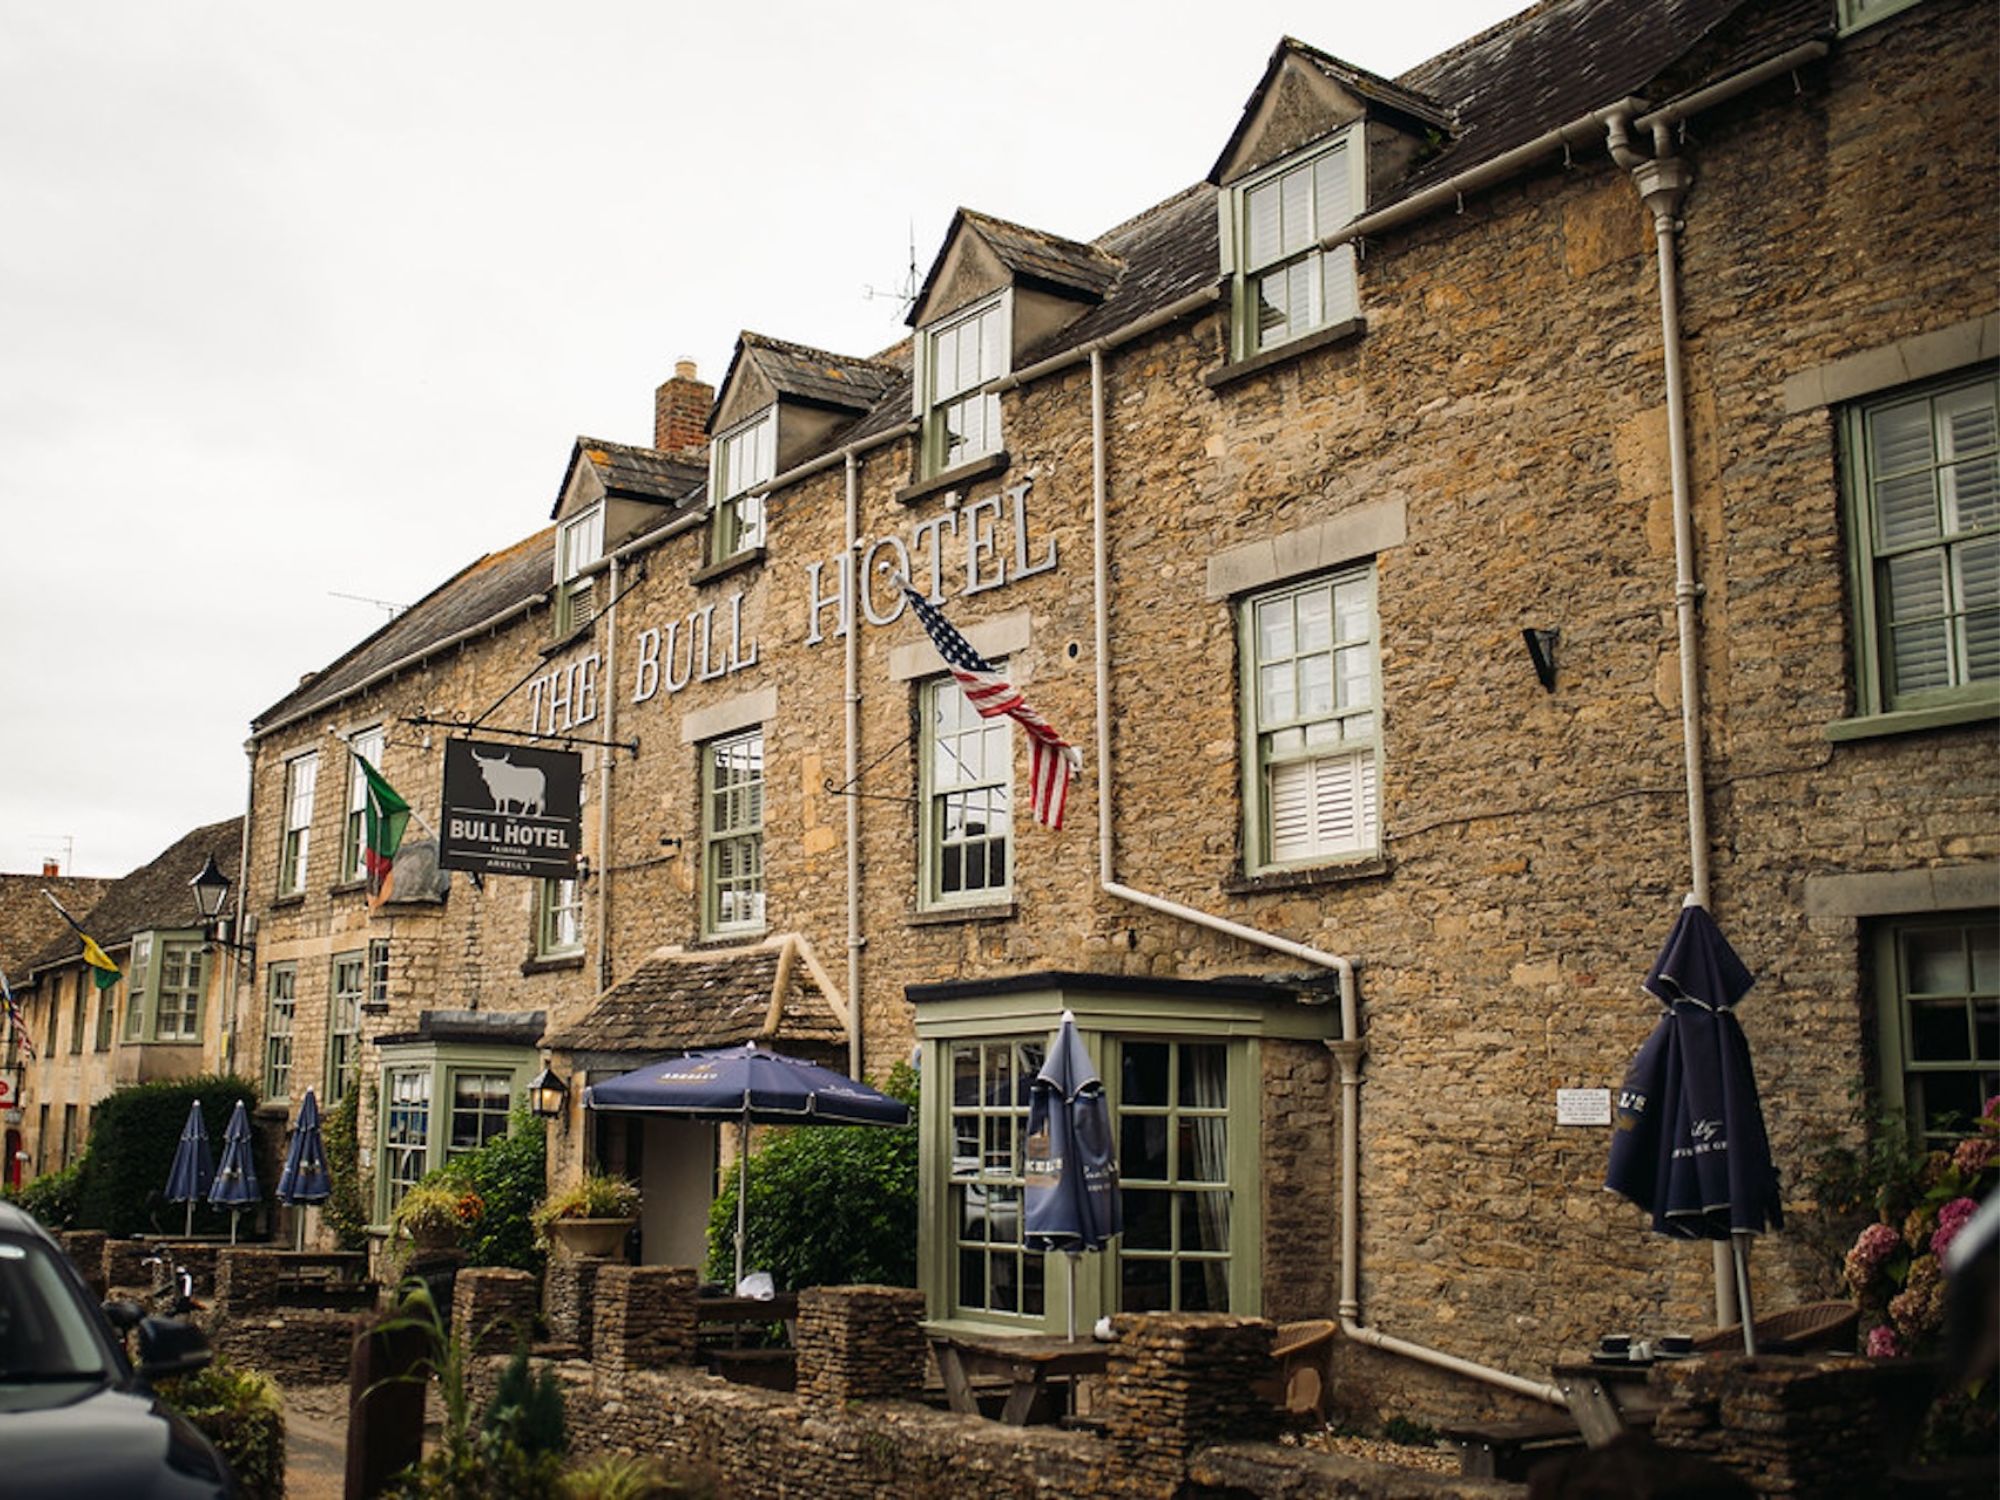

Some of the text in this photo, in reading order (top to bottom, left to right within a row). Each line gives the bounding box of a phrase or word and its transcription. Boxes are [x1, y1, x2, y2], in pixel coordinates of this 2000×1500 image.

[527, 480, 1058, 742] THE BULL HOTEL
[449, 819, 570, 849] BULL HOTEL
